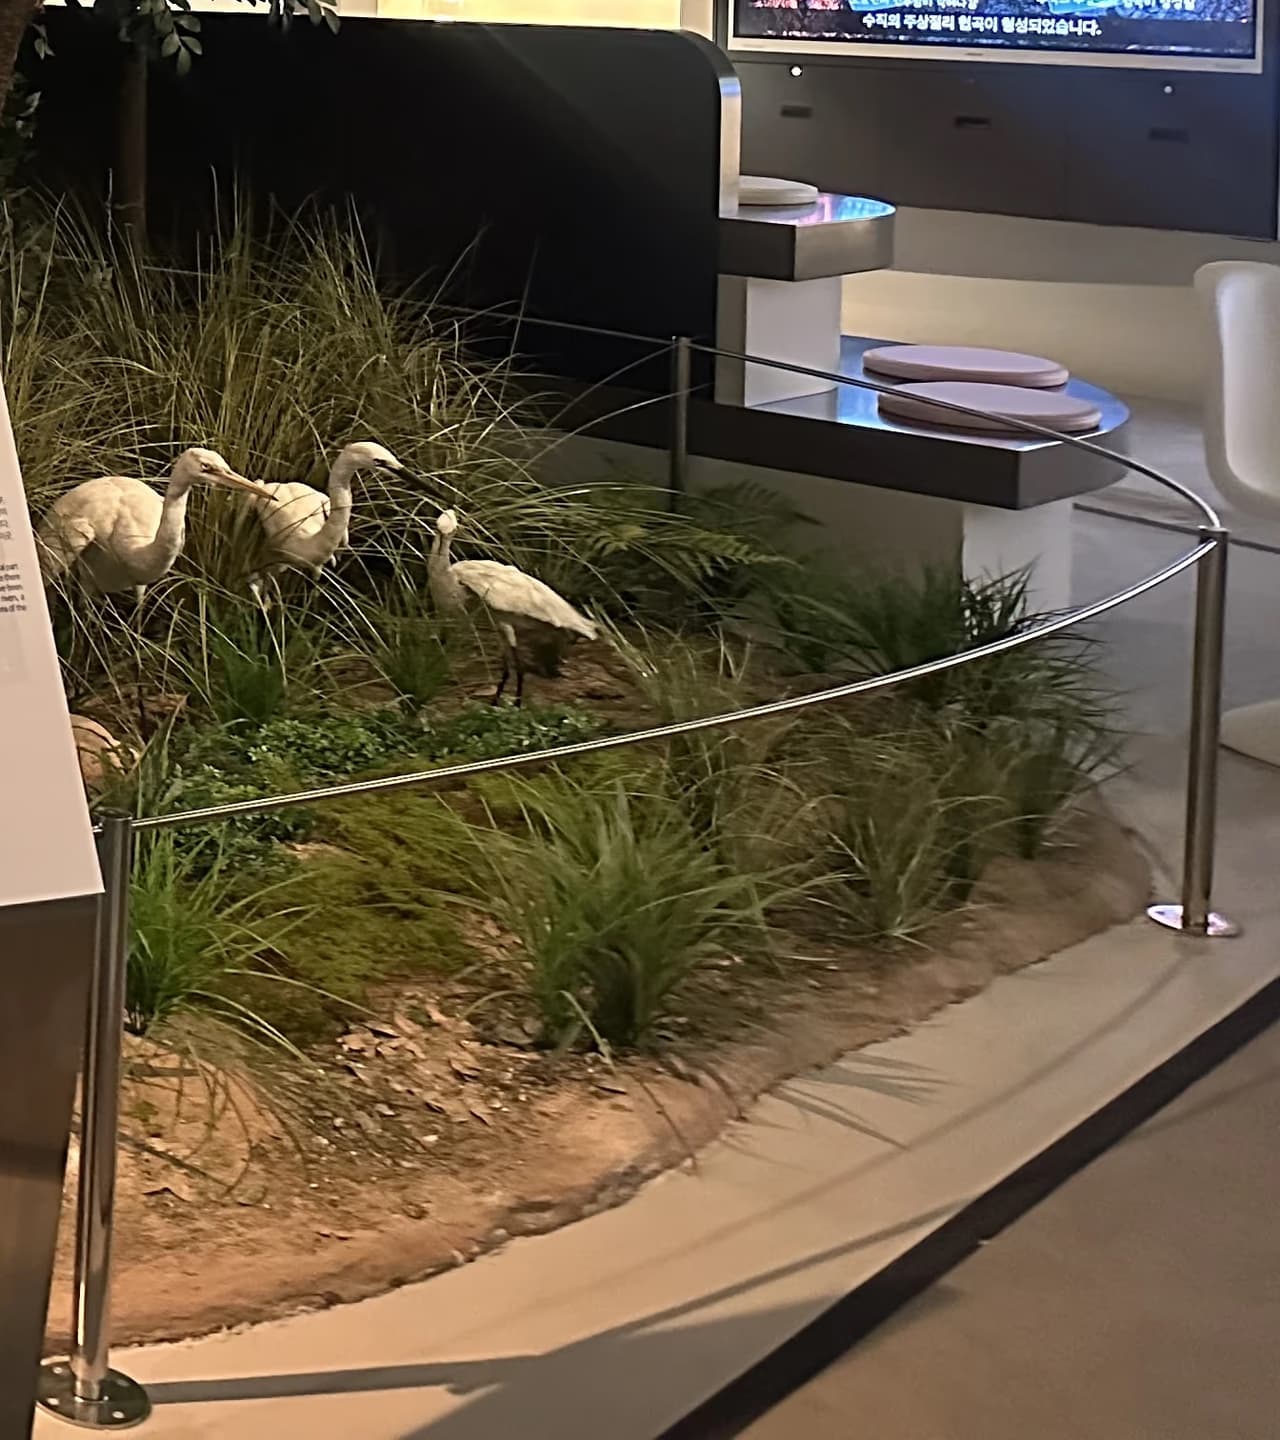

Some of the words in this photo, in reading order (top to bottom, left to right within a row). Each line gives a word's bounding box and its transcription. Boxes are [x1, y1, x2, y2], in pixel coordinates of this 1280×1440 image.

[862, 12, 901, 29] 수직의
[903, 14, 955, 32] 주상절리
[1000, 17, 1102, 35] 형성되었습니다.
